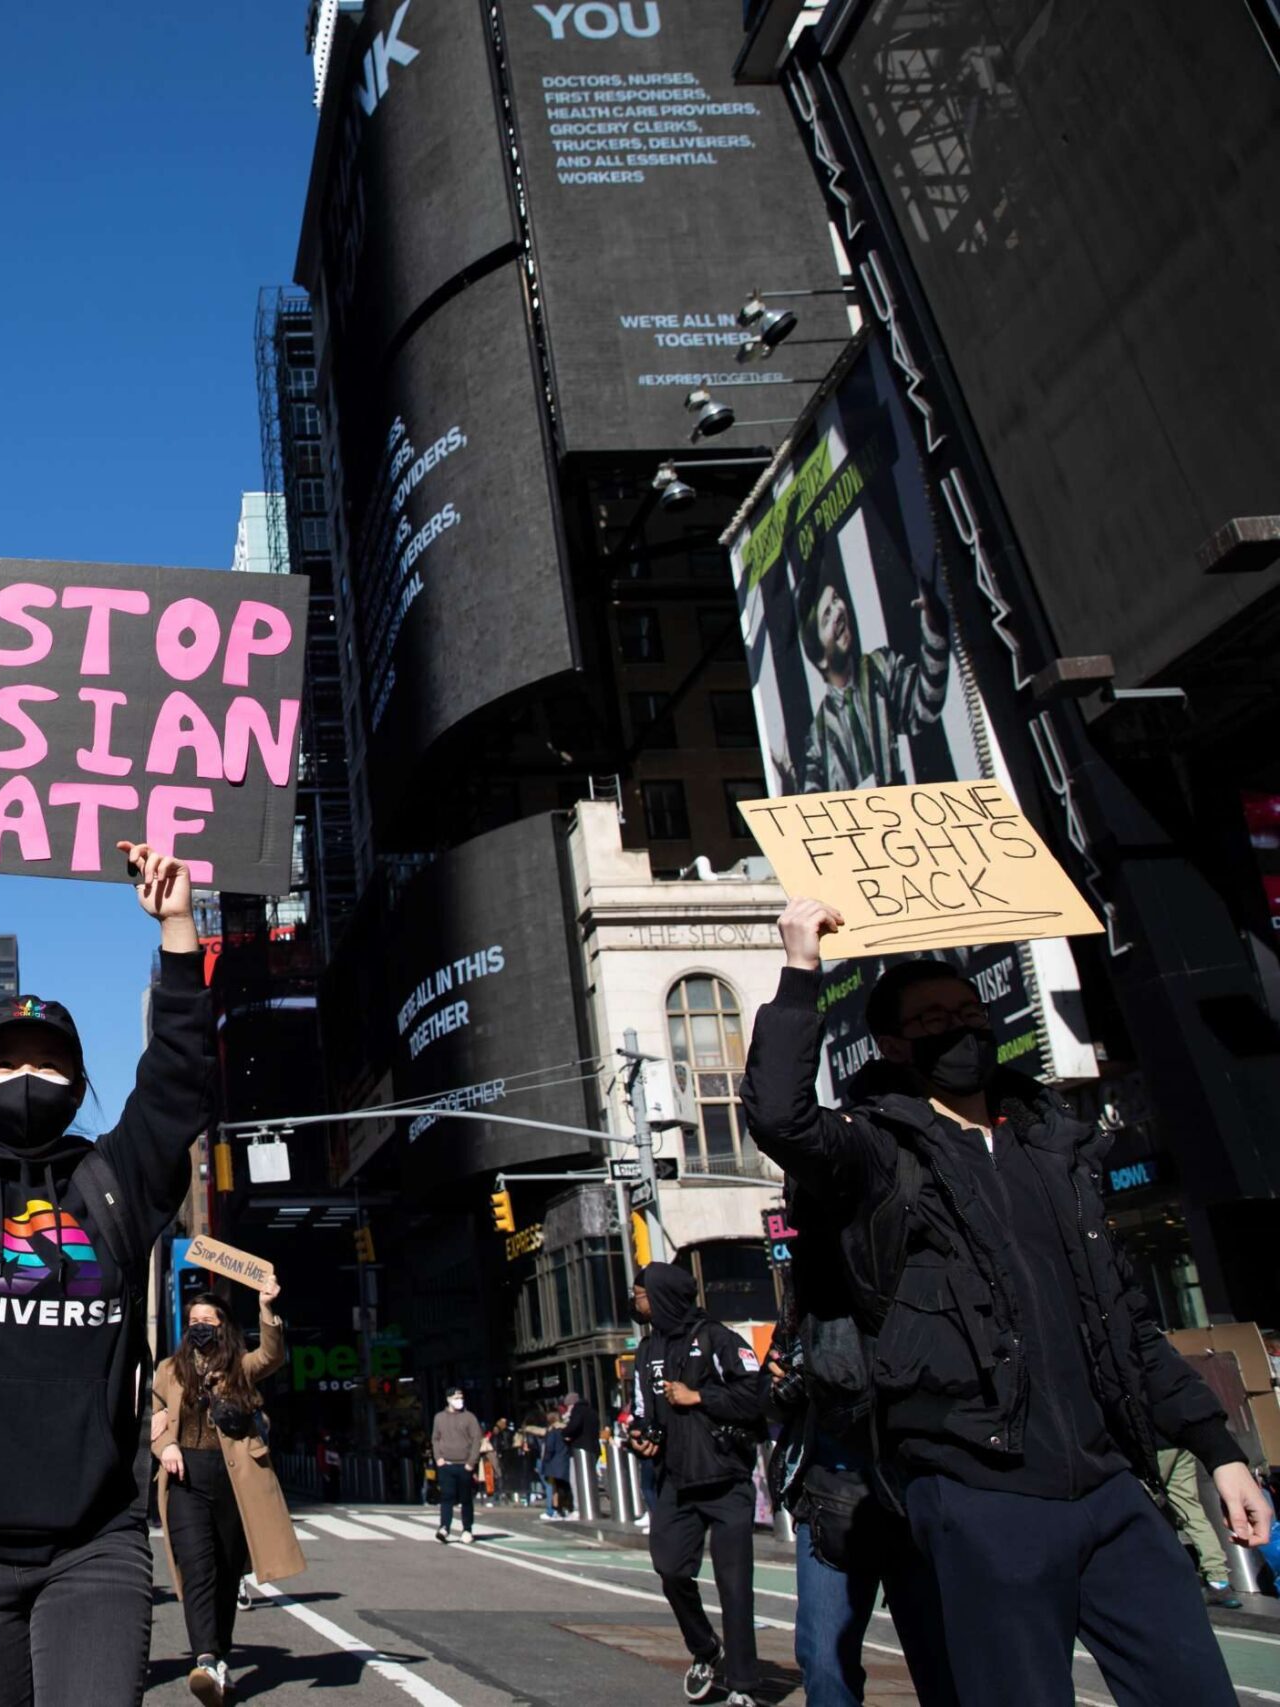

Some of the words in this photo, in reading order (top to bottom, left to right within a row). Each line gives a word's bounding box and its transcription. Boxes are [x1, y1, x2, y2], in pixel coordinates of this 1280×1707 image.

[532, 0, 661, 39] YOU
[542, 75, 627, 88] DOCTORS,
[628, 72, 700, 86] NURSES,
[544, 91, 591, 104] FIRST
[594, 88, 711, 103] RESPONDERS,
[547, 106, 610, 119] HEALTH
[612, 104, 659, 118] CARE
[660, 102, 761, 117] PROVIDERS,
[549, 121, 629, 136] GROCERY
[633, 120, 702, 134] CLERKS,
[552, 137, 647, 152] TRUCKERS,
[648, 134, 756, 149] DELIVERERS,
[556, 155, 592, 168] AND
[595, 154, 623, 167] ALL
[626, 152, 718, 166] ESSENTIAL
[558, 170, 645, 185] WORKERS
[620, 314, 679, 329] WE'RE
[683, 313, 714, 328] ALL
[717, 314, 736, 328] IN
[749, 796, 902, 837] THIS
[910, 785, 1019, 826] ONE
[802, 821, 1037, 875] FIGHTS
[857, 867, 1011, 916] BACK
[634, 924, 680, 945] THE
[688, 923, 755, 945] SHOW
[416, 976, 436, 1010] ALL
[435, 965, 454, 997] IN
[453, 945, 505, 986] THIS
[408, 999, 470, 1061] TOGETHER
